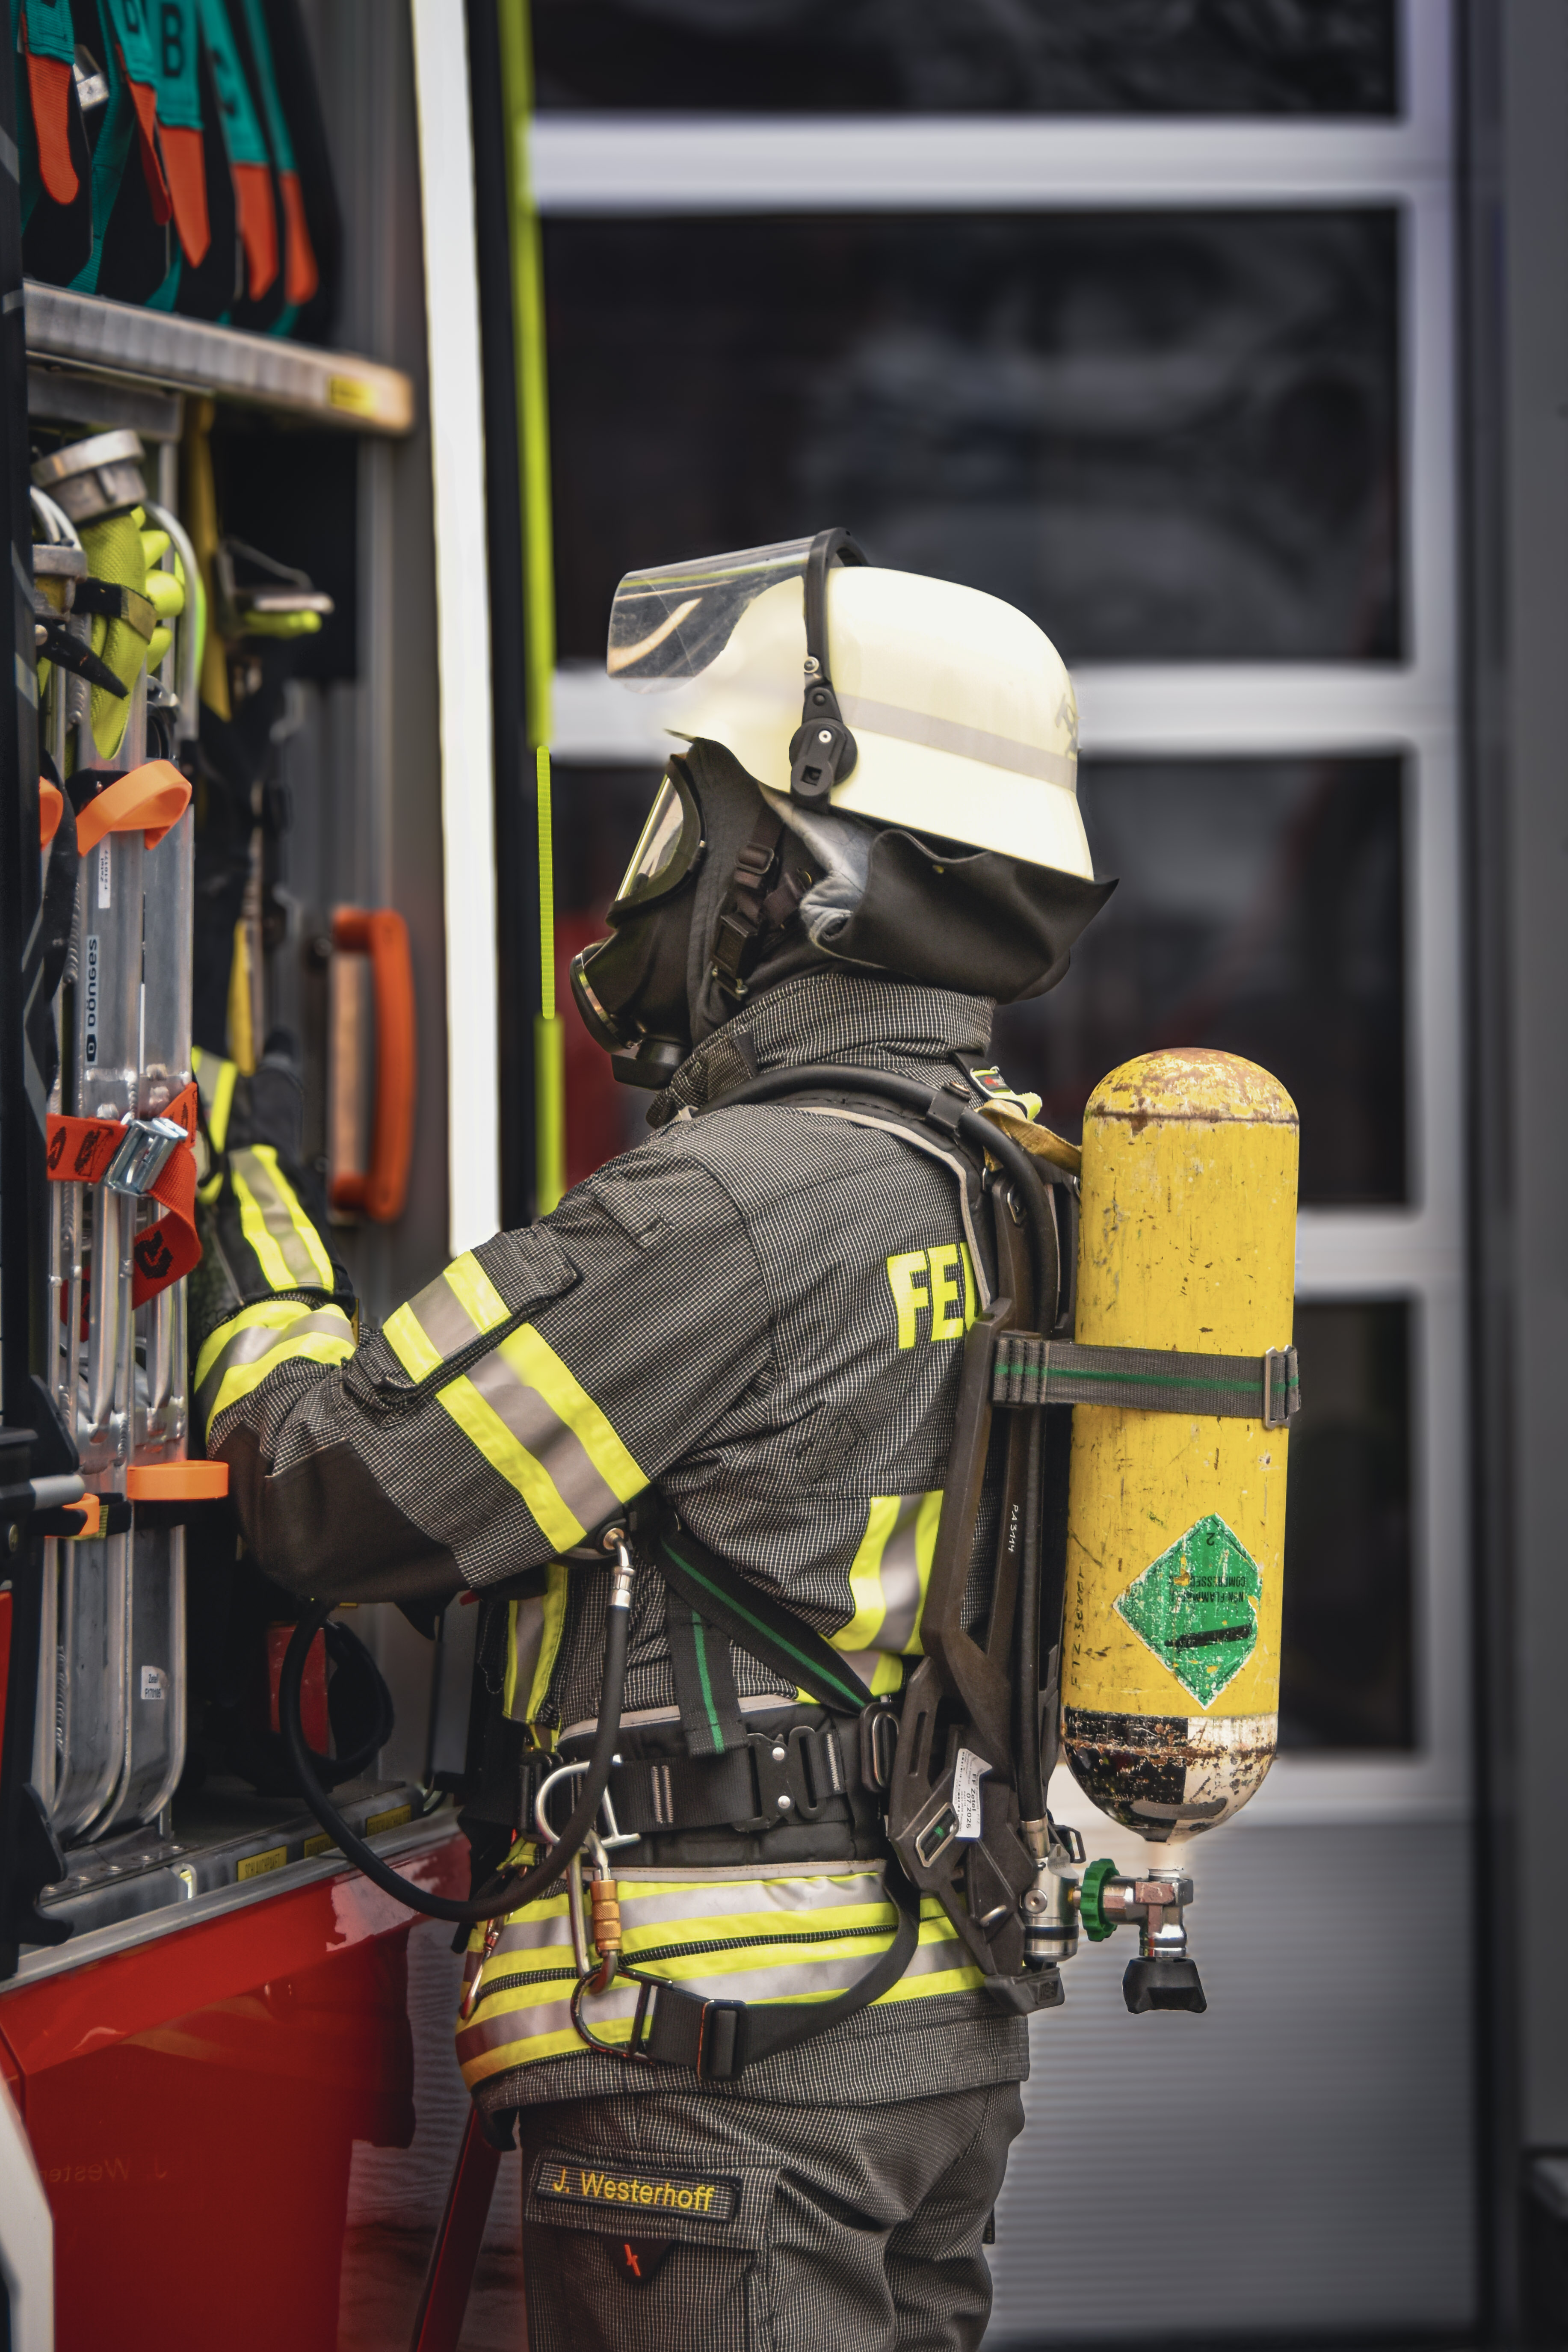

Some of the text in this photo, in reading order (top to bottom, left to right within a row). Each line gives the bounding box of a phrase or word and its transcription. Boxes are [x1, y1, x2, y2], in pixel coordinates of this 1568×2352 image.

[1206, 1532, 1215, 1546] 2
[553, 2168, 715, 2211] J. Westerhoff
